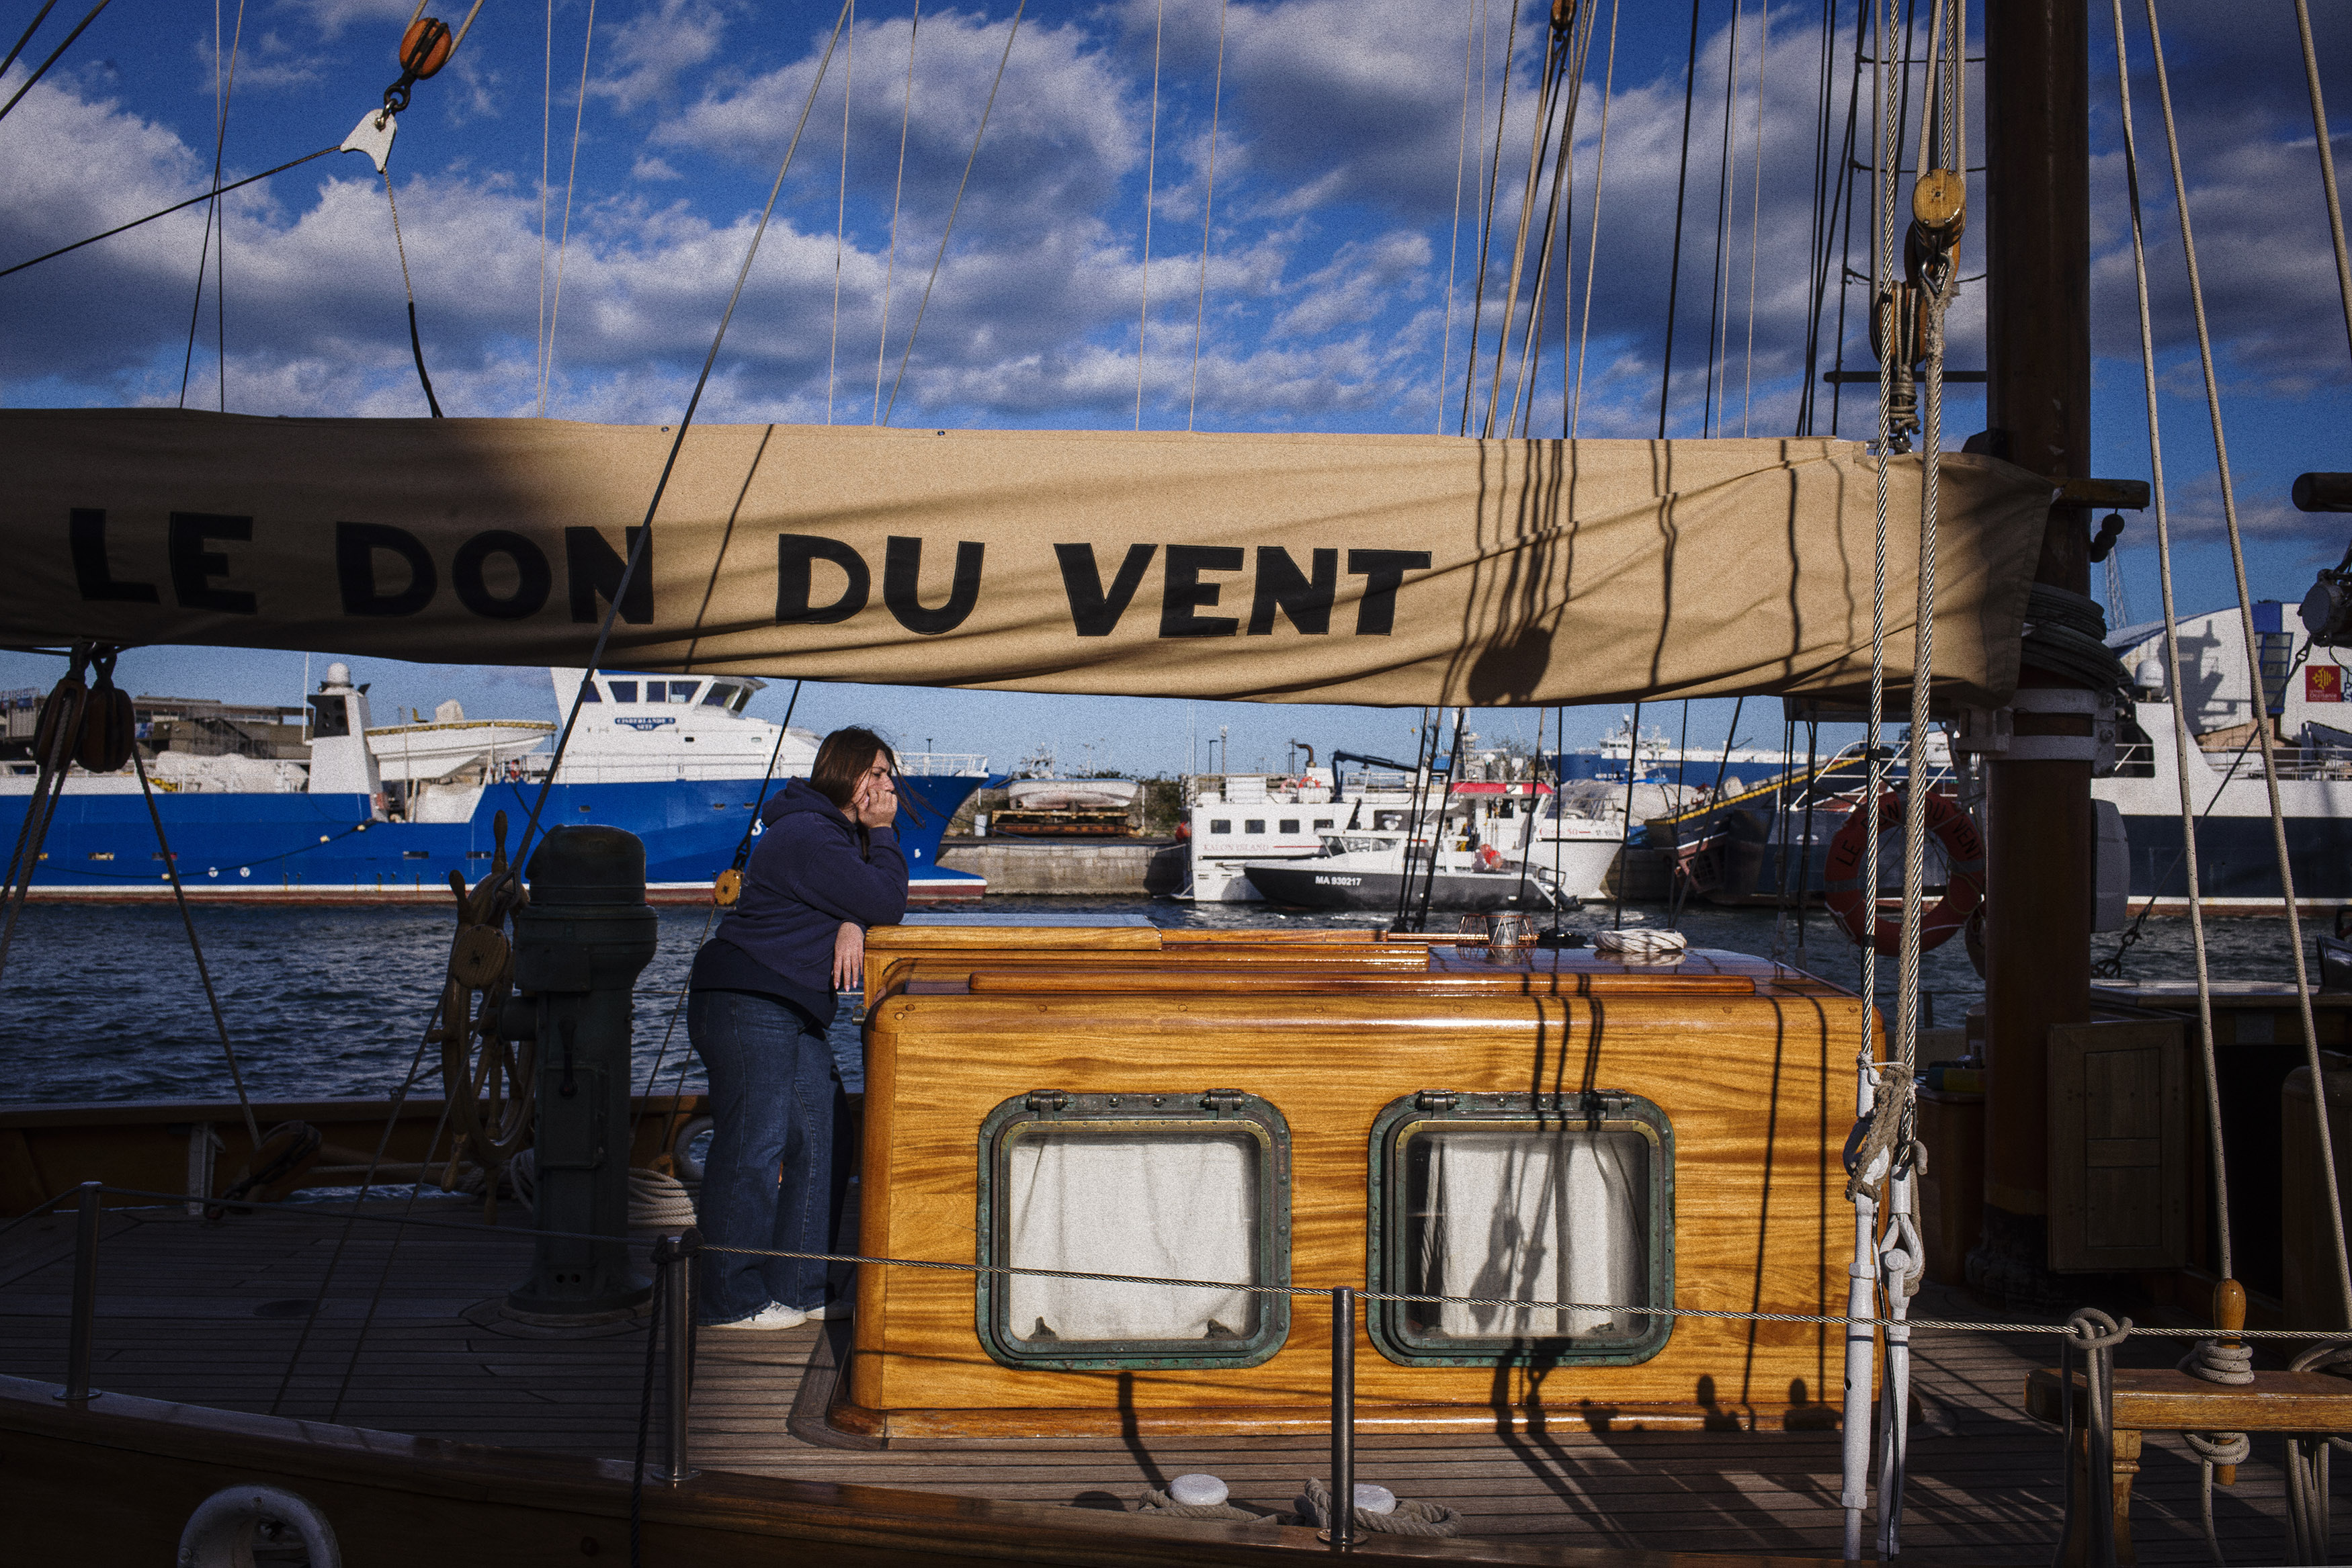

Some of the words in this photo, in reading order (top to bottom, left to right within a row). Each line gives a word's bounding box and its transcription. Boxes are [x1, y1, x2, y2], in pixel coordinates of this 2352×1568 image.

[69, 507, 258, 615] LE
[335, 521, 655, 625] DON
[775, 533, 985, 636] DU
[1053, 542, 1432, 639] VENT
[1835, 839, 1861, 867] LE
[1953, 818, 1983, 860] VENT
[1315, 875, 1331, 885] MA
